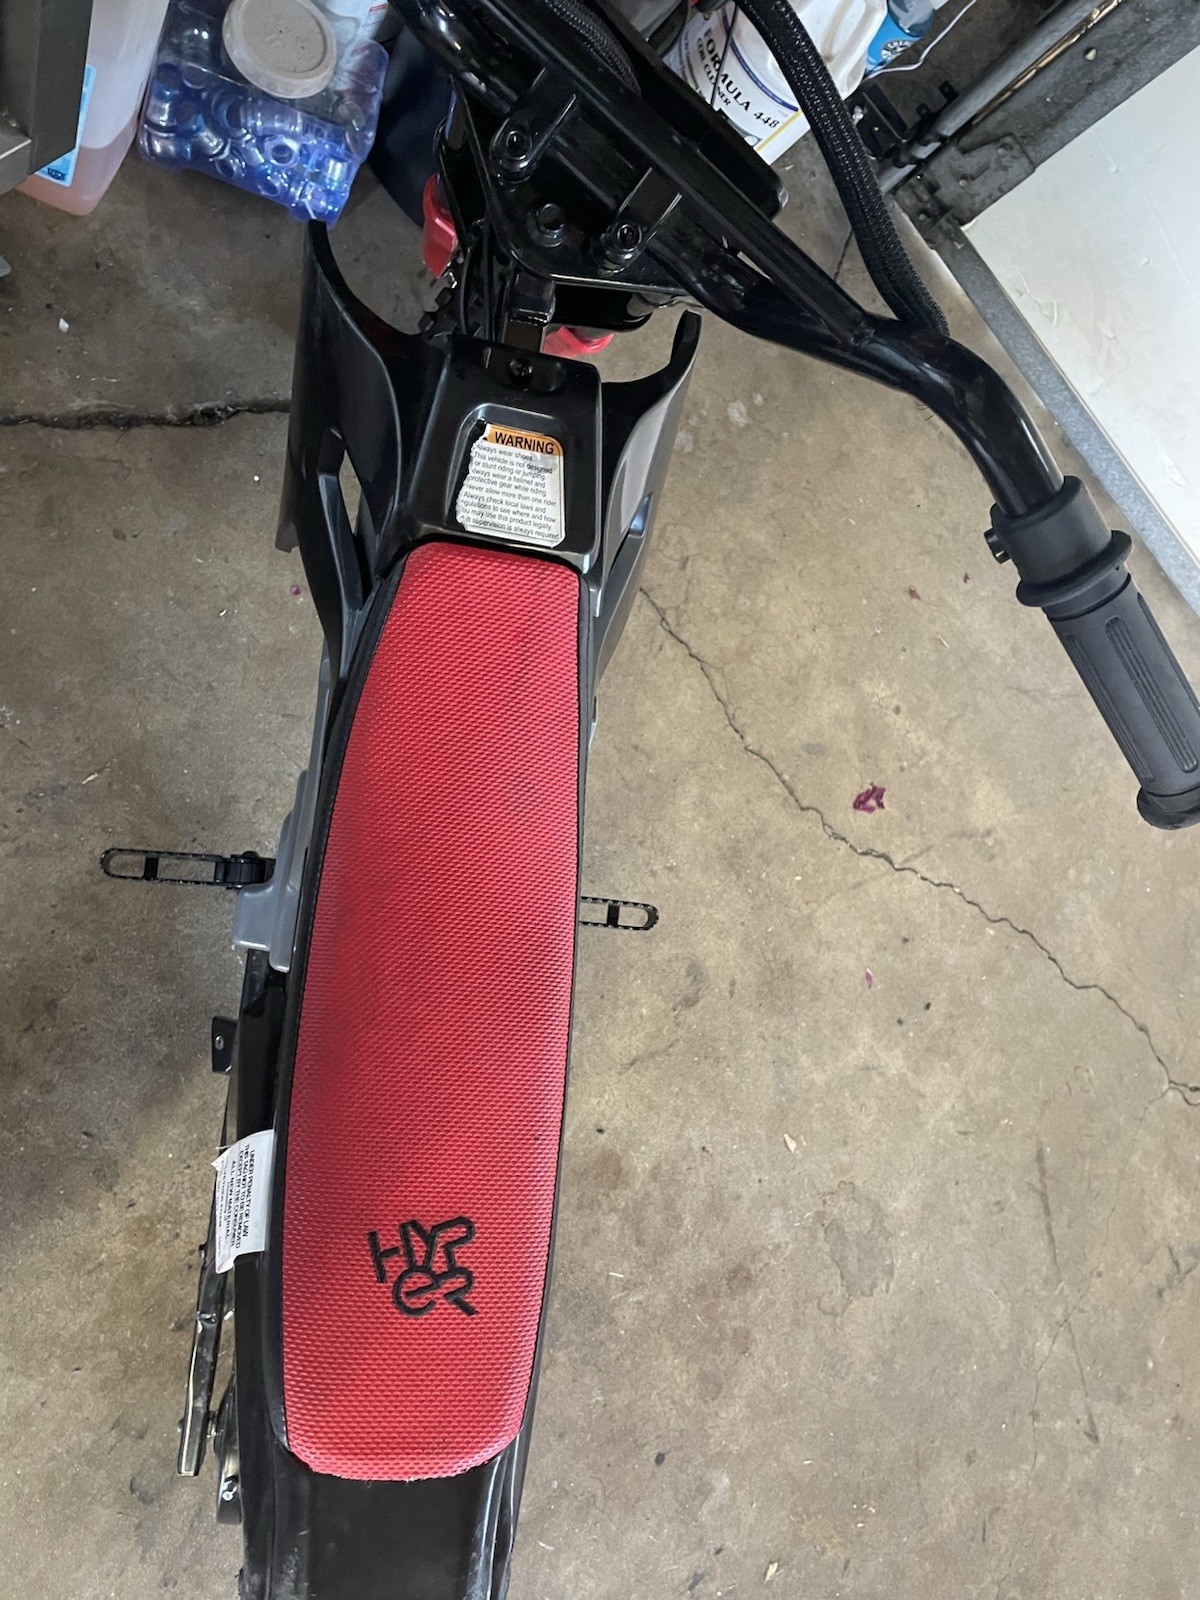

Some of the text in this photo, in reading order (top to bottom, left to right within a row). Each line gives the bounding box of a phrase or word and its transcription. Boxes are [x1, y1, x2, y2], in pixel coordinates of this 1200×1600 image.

[704, 64, 731, 106] CLENER
[754, 112, 779, 128] 448
[494, 431, 554, 454] WARNING
[514, 452, 532, 460] shoes
[487, 455, 508, 464] vehicle
[526, 463, 552, 475] designed
[497, 465, 514, 474] riding
[521, 470, 545, 481] jumping
[513, 476, 533, 485] helmet
[498, 481, 512, 490] gear
[530, 487, 546, 496] riding
[463, 491, 485, 501] Always
[486, 495, 503, 504] check
[504, 499, 519, 507] local
[512, 509, 530, 517] where
[472, 517, 505, 529] supervision
[513, 526, 533, 536] always
[509, 517, 531, 527] product
[240, 1191, 246, 1200] TO
[244, 1208, 251, 1218] OF
